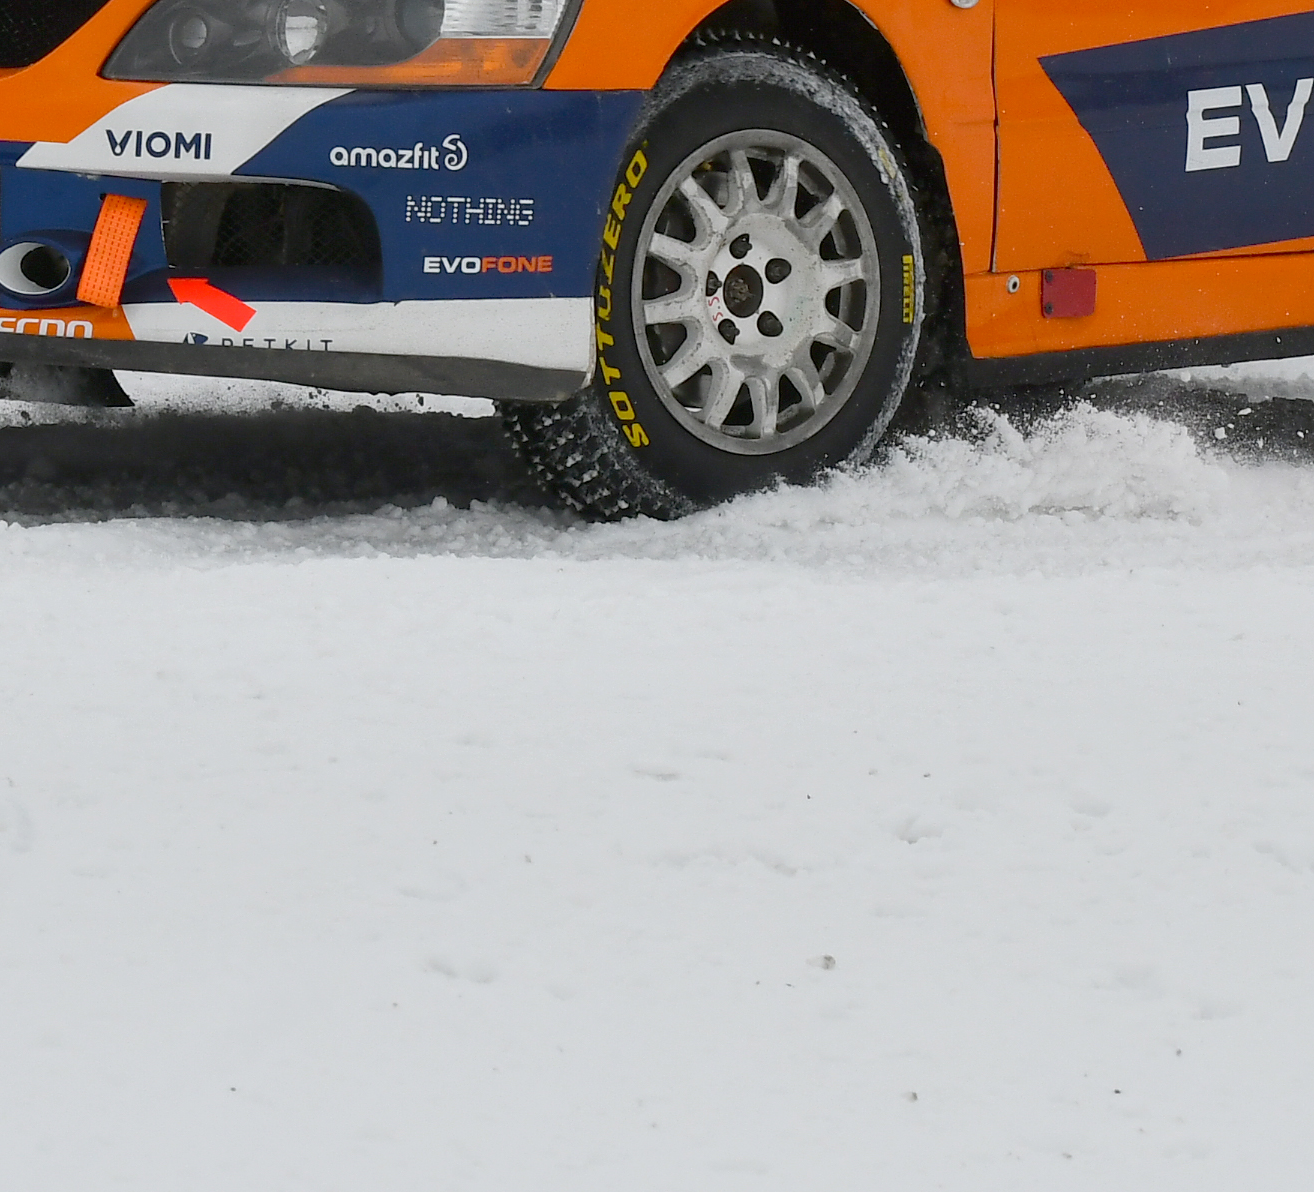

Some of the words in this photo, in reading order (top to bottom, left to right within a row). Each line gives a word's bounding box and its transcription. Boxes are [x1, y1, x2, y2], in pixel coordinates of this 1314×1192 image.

[105, 129, 212, 161] VIOMI
[330, 141, 440, 171] amazfit
[405, 194, 535, 227] NOTHING
[423, 256, 554, 275] EVOFONE
